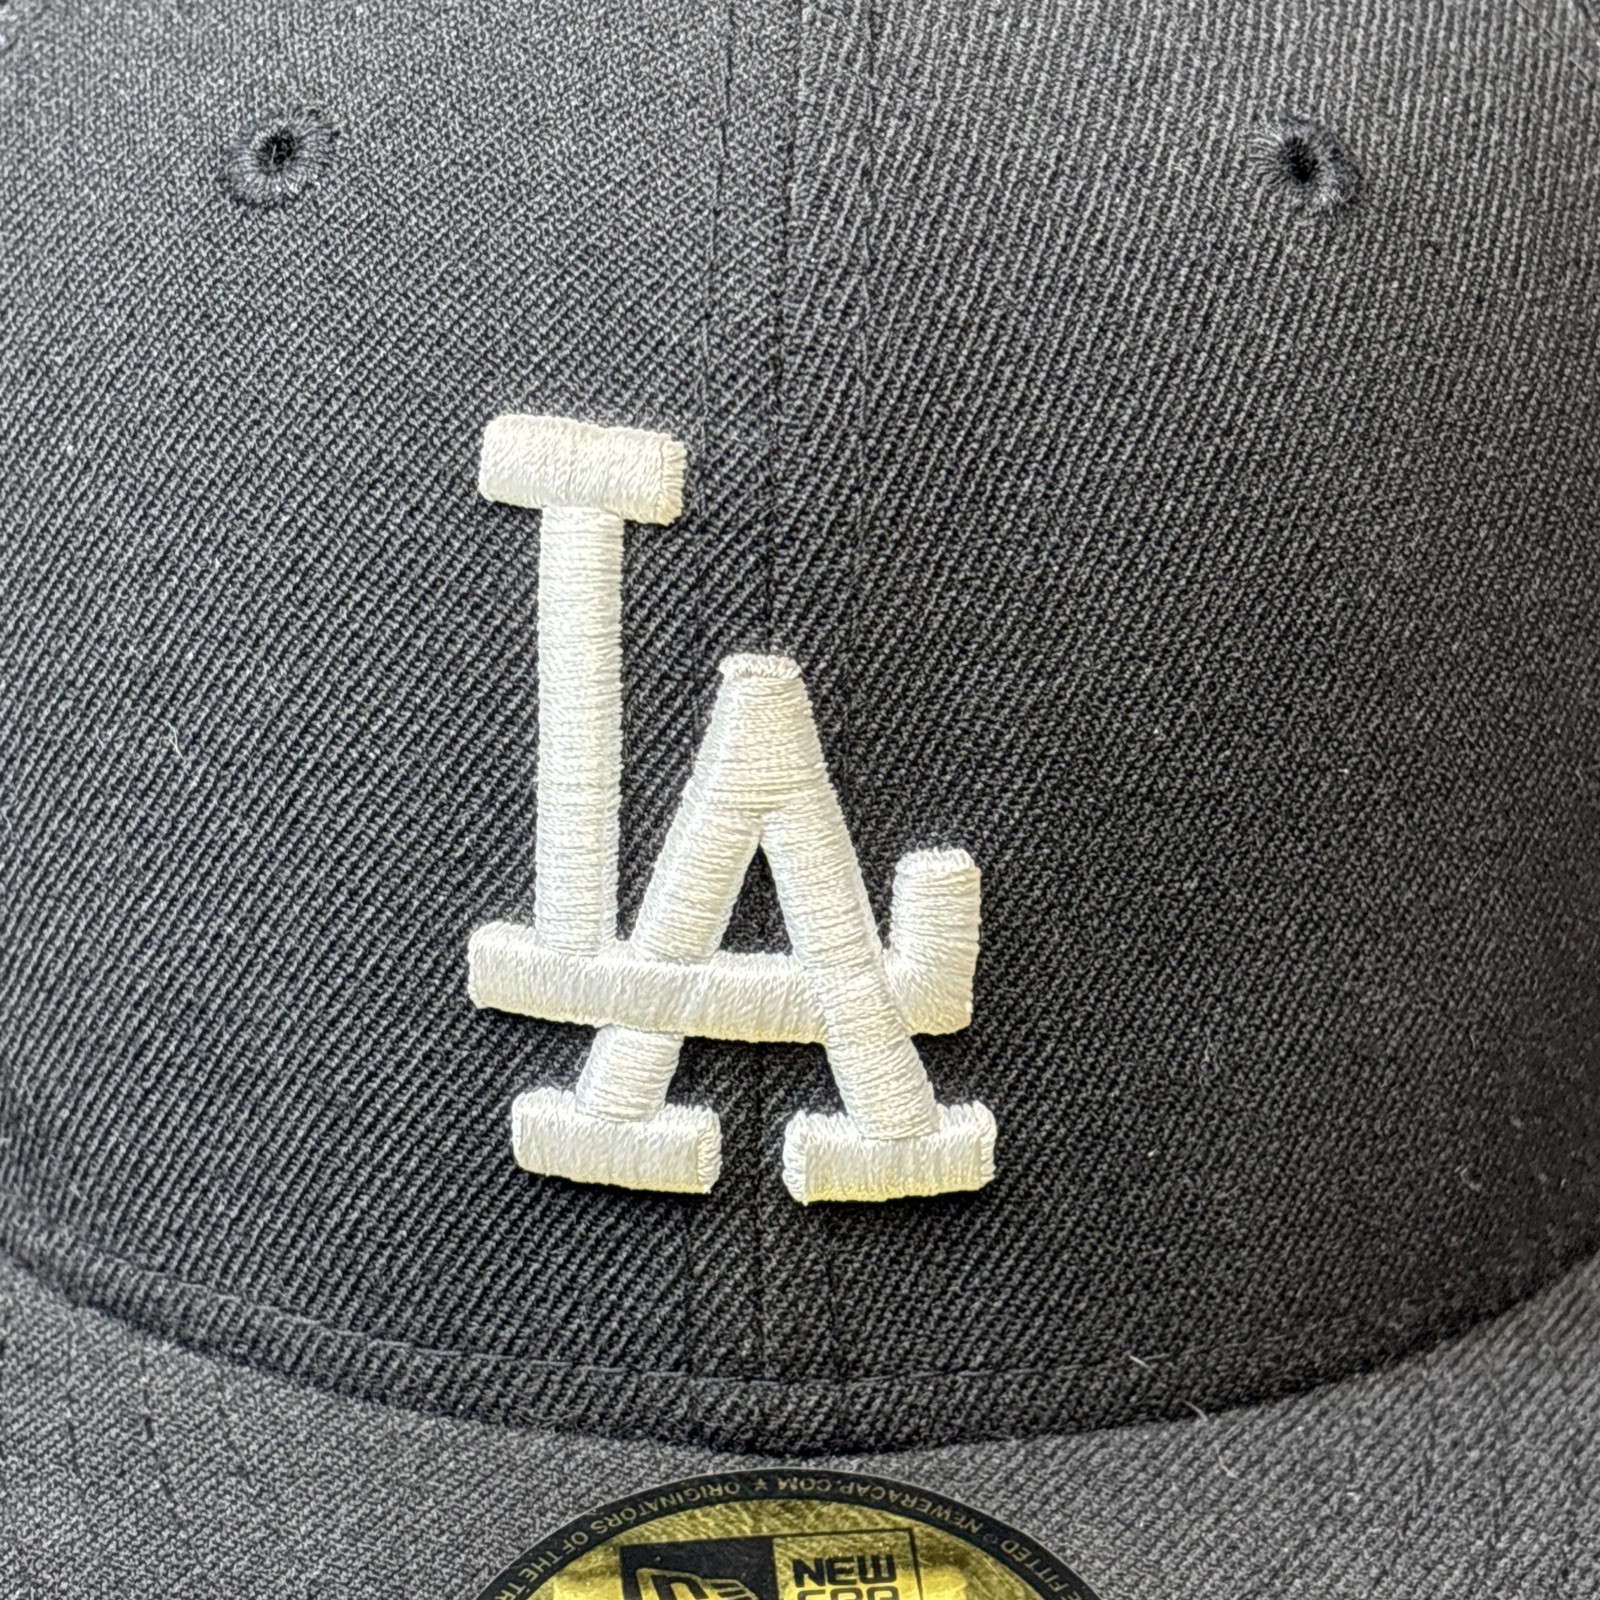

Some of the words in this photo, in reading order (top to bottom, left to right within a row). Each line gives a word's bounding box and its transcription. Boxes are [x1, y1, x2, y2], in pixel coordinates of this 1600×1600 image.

[467, 413, 998, 1205] LA
[590, 1481, 741, 1534] ORIGINATORS
[777, 1477, 984, 1534] NEWERACAP.COM
[518, 1550, 564, 1582] THE
[562, 1531, 589, 1555] OF
[1000, 1540, 1069, 1592] FITTED
[792, 1554, 897, 1588] NEW
